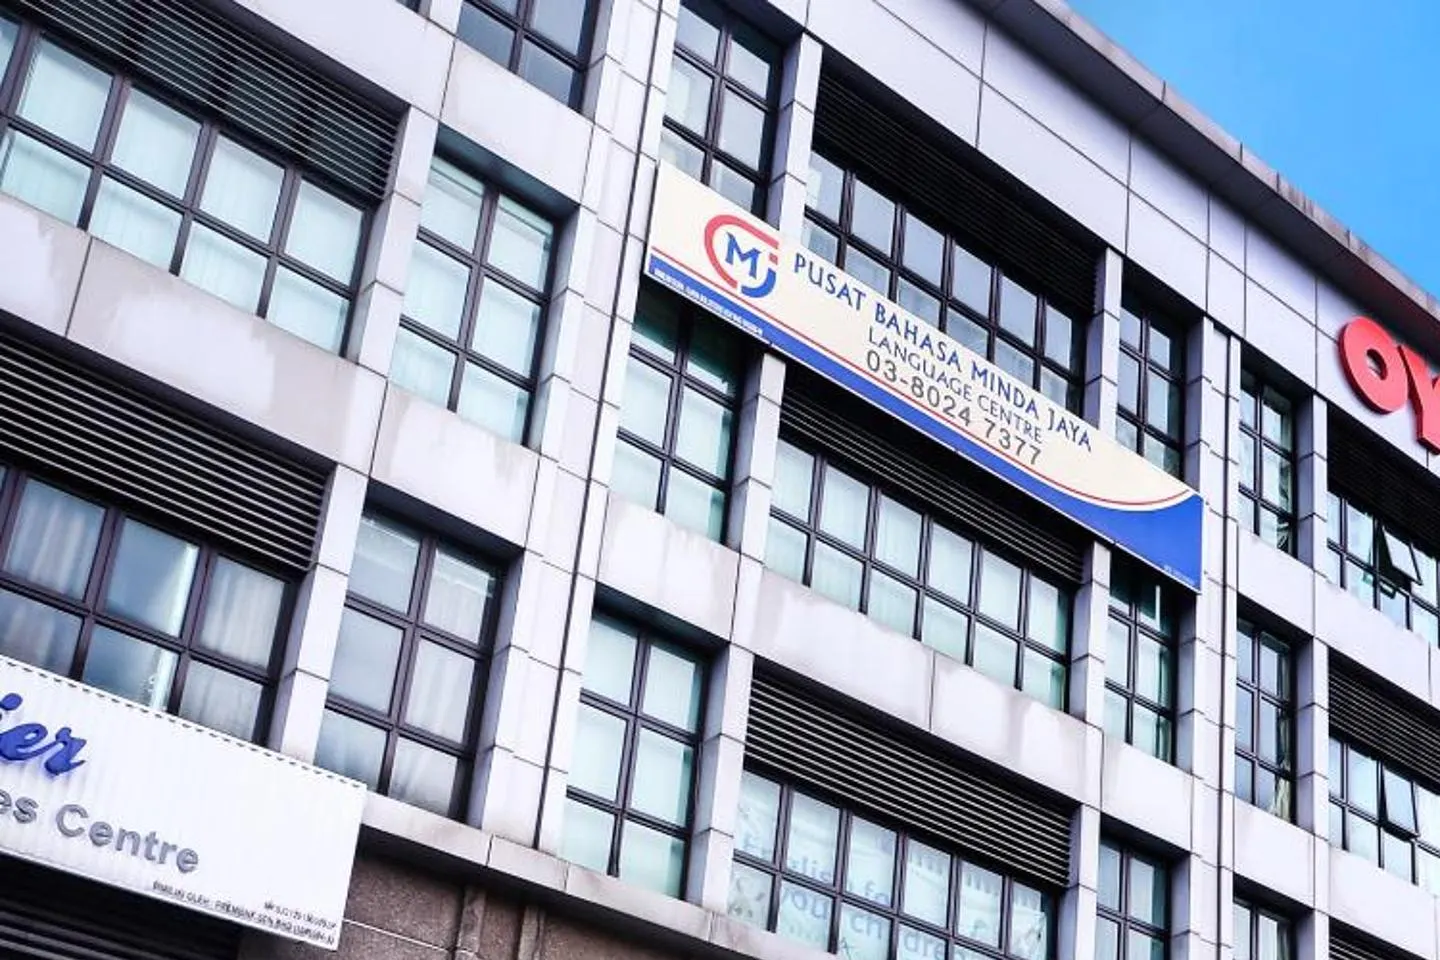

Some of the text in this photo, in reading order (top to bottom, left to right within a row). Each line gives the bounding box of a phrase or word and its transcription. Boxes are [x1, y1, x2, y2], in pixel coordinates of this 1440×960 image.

[794, 252, 866, 311] PUSAT
[874, 301, 962, 373] BAHASA
[971, 360, 1040, 421] MINDA
[1047, 407, 1092, 453] JAYA
[867, 349, 1042, 466] 03-8024 7377
[869, 326, 1044, 445] LANGUAGE CENTRE
[55, 803, 200, 874] Centre
